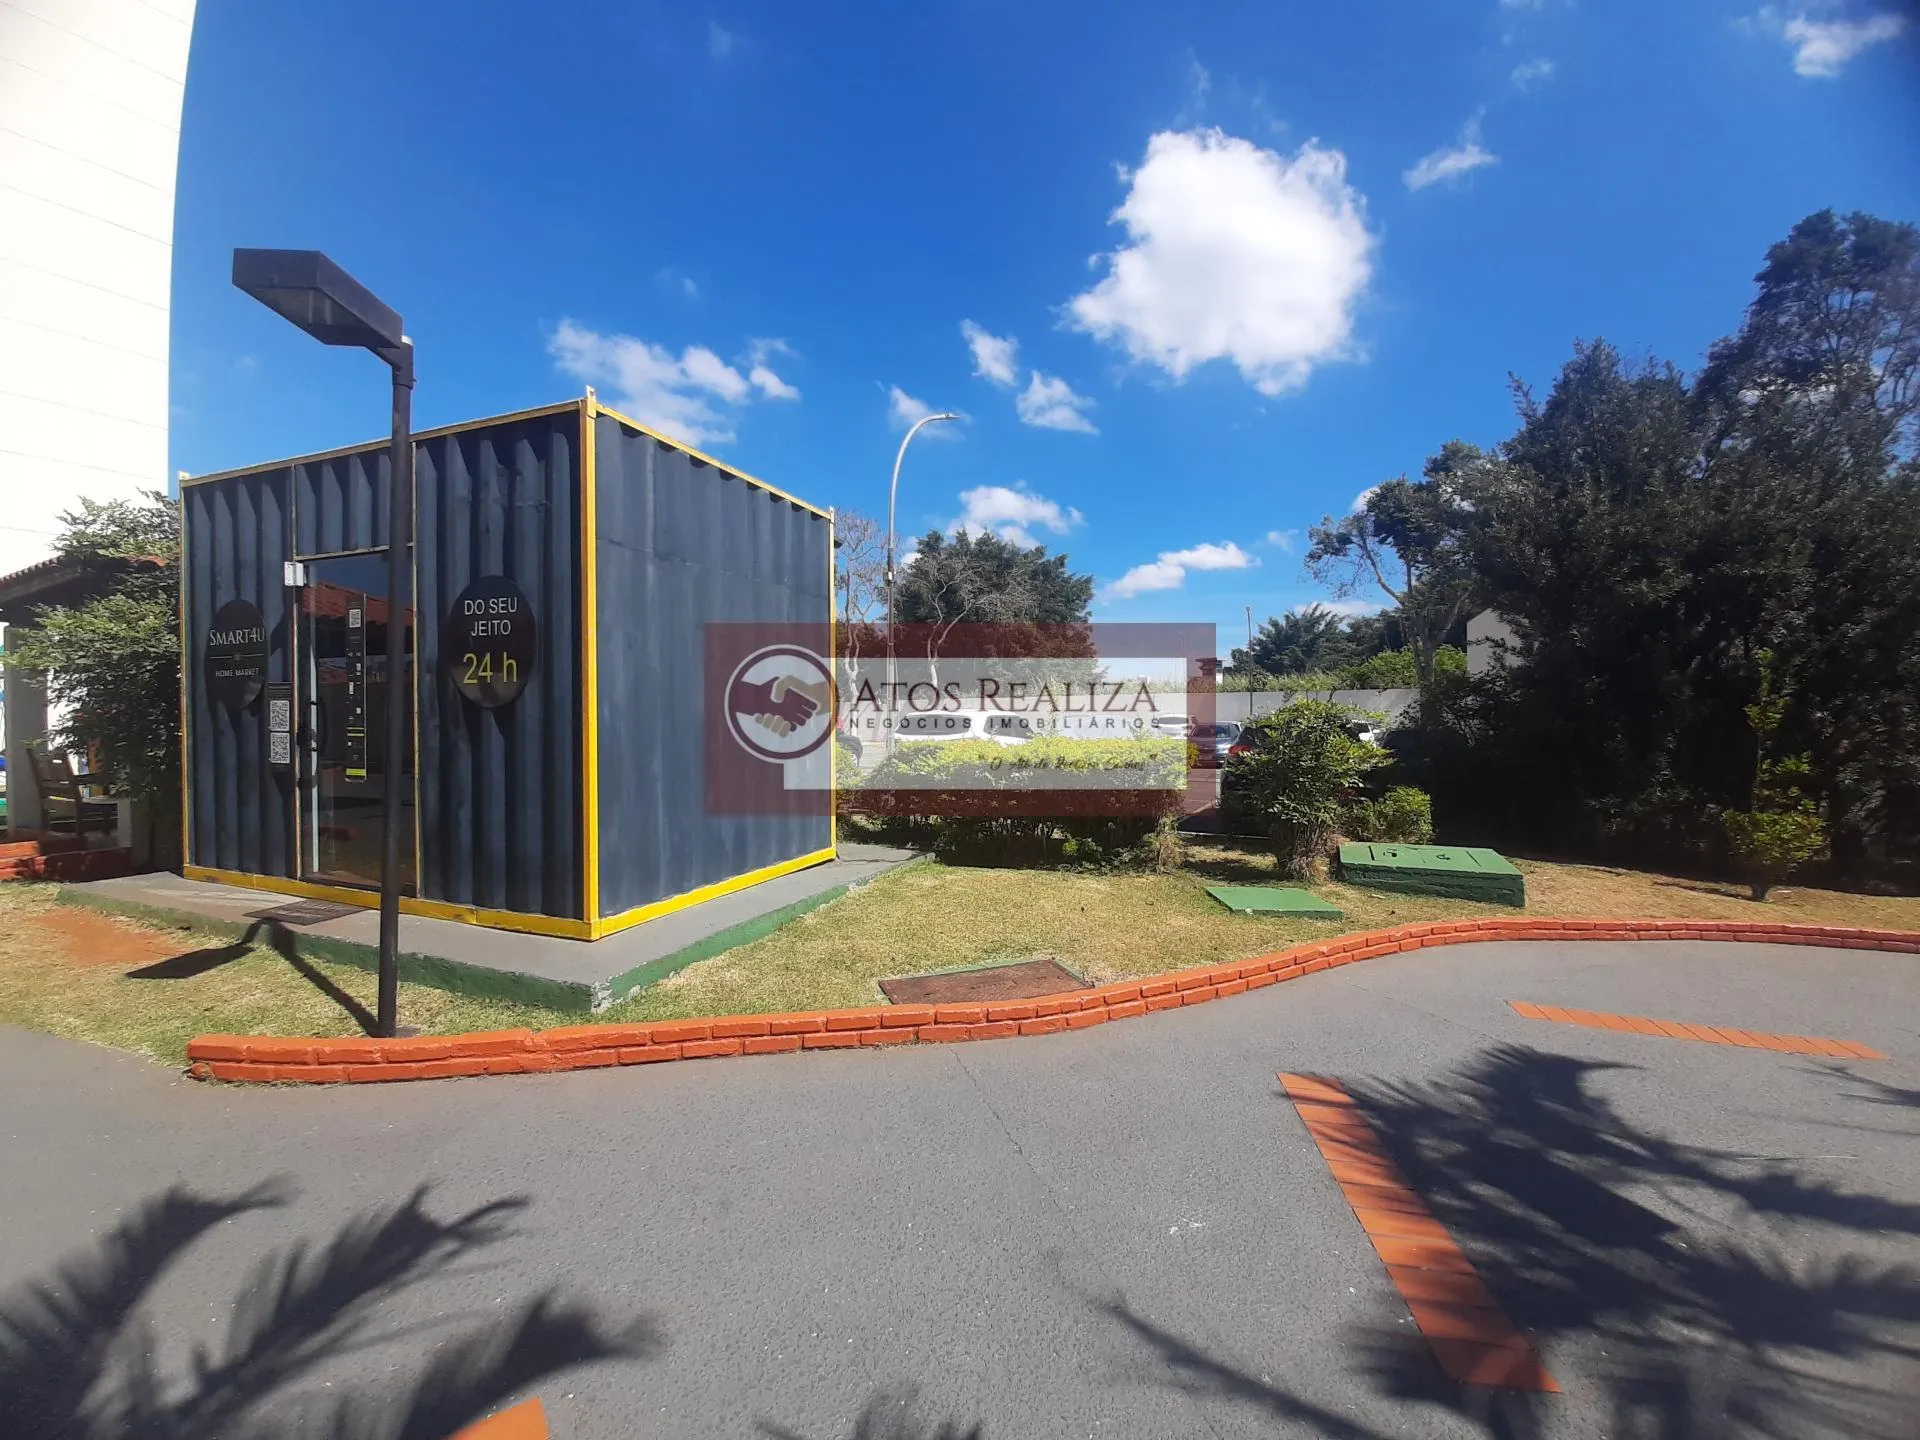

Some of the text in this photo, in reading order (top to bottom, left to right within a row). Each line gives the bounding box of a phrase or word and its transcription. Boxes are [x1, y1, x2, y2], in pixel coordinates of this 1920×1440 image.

[464, 597, 518, 615] DO SEU
[471, 620, 511, 637] JEITO
[216, 667, 260, 677] HOME MARKET
[463, 651, 518, 684] 24 h
